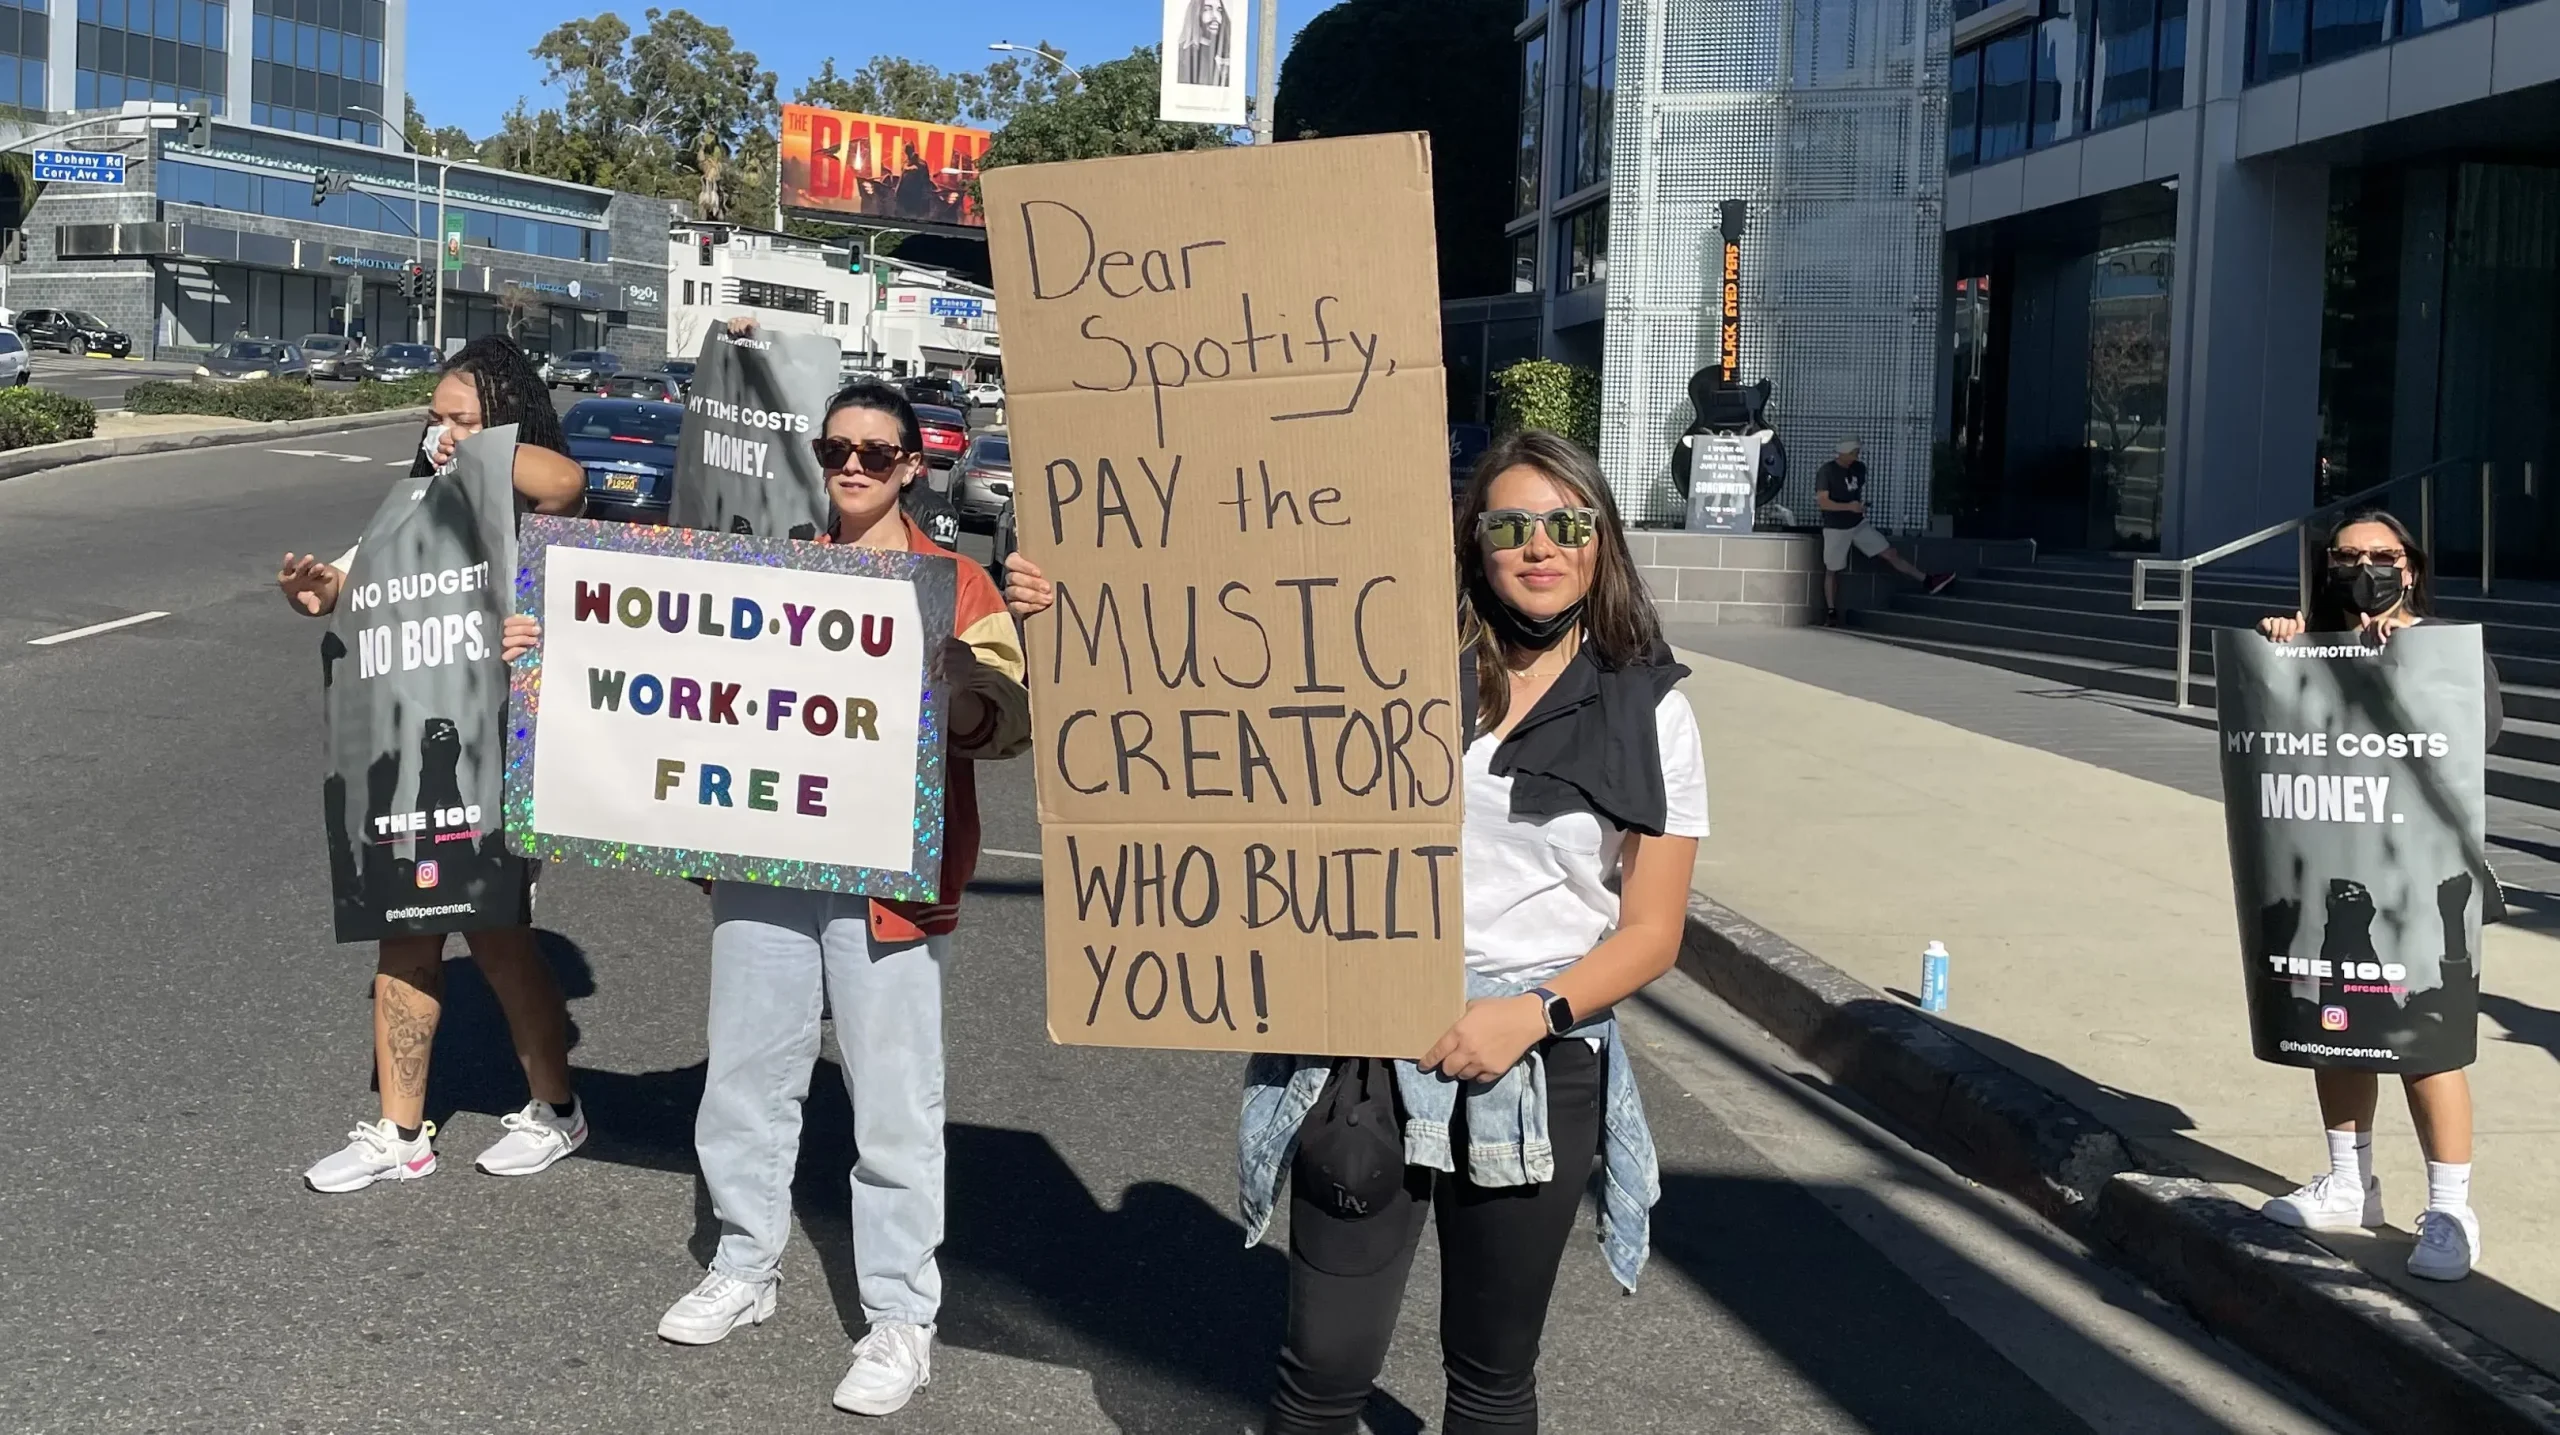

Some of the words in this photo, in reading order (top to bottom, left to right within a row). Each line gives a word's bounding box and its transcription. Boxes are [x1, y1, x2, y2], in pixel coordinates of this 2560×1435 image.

[788, 112, 808, 132] THE
[42, 167, 71, 180] Cory
[77, 169, 98, 180] Ave
[55, 153, 99, 168] Doheny
[106, 156, 121, 167] Rd
[1021, 200, 1226, 300] Dear
[630, 284, 658, 302] 9201
[1724, 282, 1738, 318] EYED
[1072, 293, 1396, 448] Spotify,
[1723, 322, 1737, 369] BLACK
[689, 395, 703, 414] MY
[705, 398, 739, 423] TIME
[741, 407, 809, 433] COSTS
[703, 430, 774, 480] MONEY.
[1044, 455, 1182, 548] PAY
[1219, 460, 1351, 532] the
[1695, 481, 1750, 495] SONGWRITER
[351, 582, 382, 612] NO
[387, 560, 489, 604] BUDGET?
[359, 625, 392, 679] NO
[401, 610, 490, 671] BOPS.
[782, 602, 895, 657] YOU
[1053, 576, 1407, 694] MUSIC
[766, 688, 880, 741] FOR
[1057, 698, 1455, 810] CREATORS
[2227, 731, 2255, 754] MY
[2260, 732, 2328, 757] TIME
[2336, 732, 2449, 758] COSTS
[653, 758, 829, 818] FREE
[2260, 772, 2405, 824] MONEY.
[374, 811, 427, 834] THE
[433, 805, 481, 828] 100
[1067, 835, 1220, 928] WHO
[1240, 843, 1458, 940] BUILT
[1084, 945, 1269, 1033] YOU!
[2269, 955, 2333, 978] THE
[2341, 962, 2407, 980] 100
[2343, 984, 2407, 994] percenters
